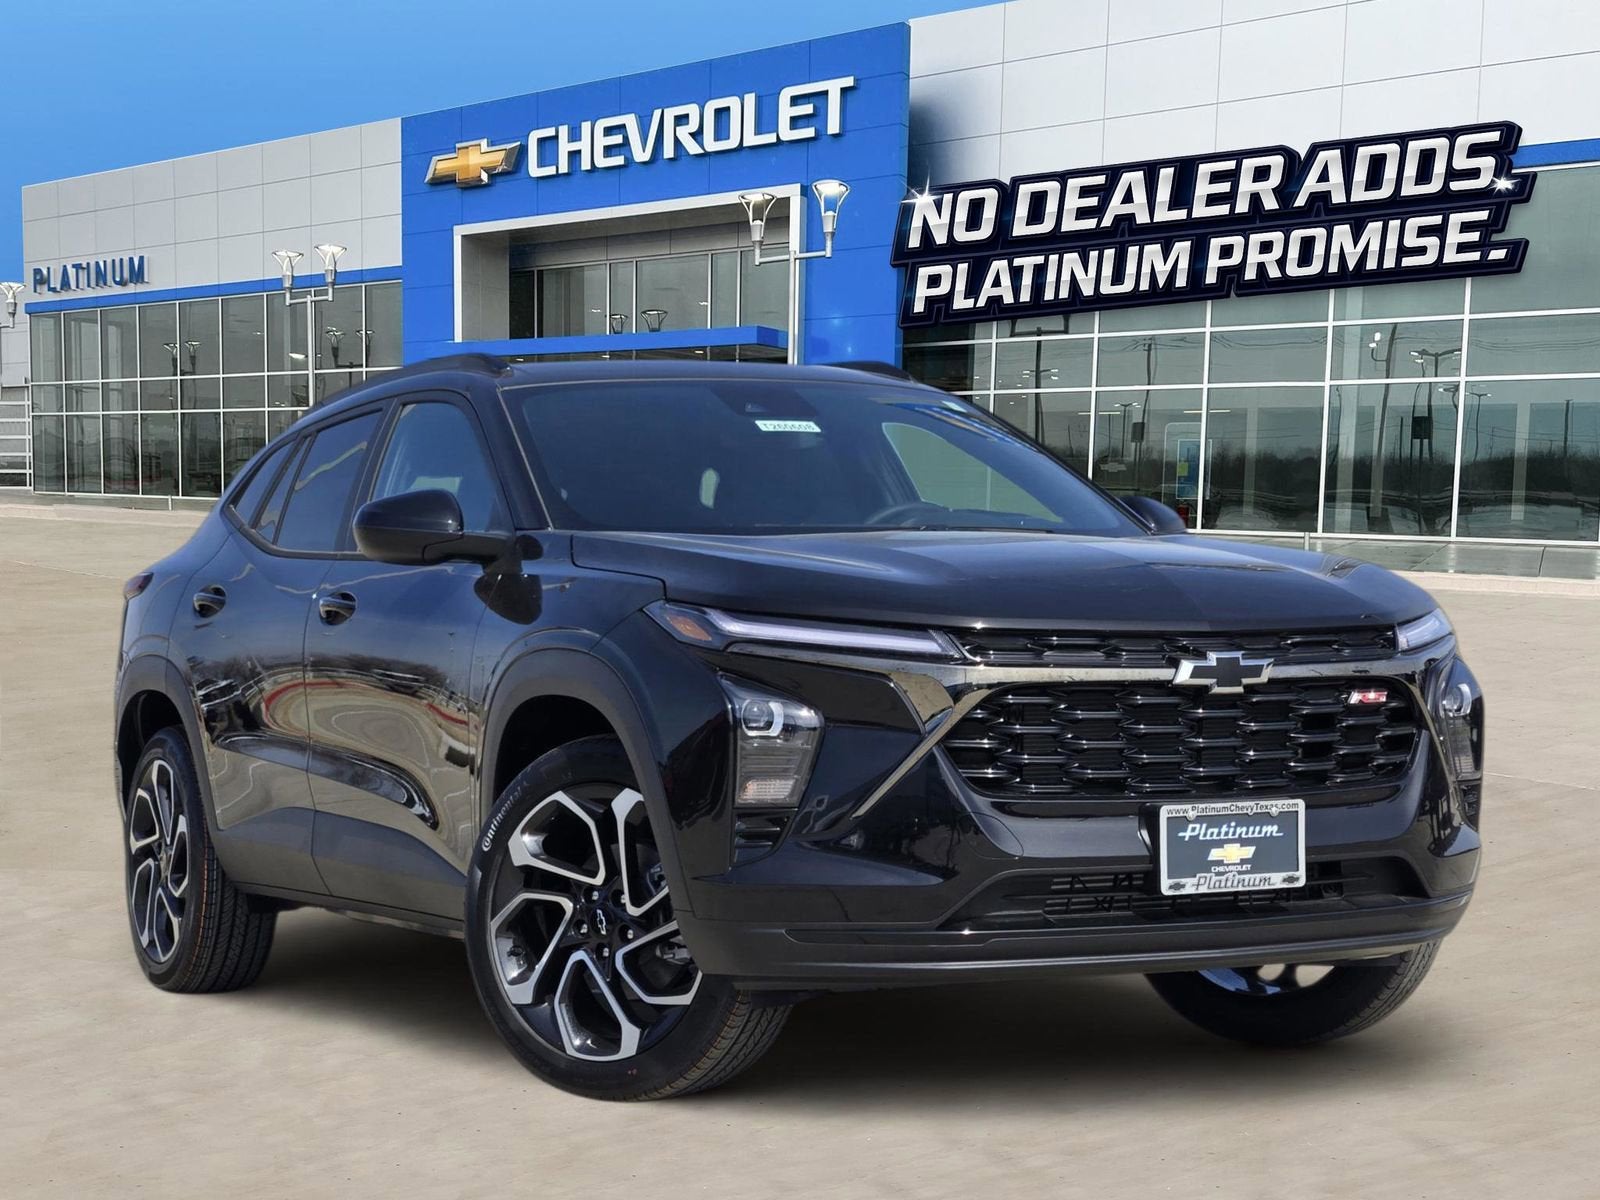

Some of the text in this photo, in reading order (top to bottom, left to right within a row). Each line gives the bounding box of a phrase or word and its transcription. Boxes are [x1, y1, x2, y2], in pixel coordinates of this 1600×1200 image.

[528, 75, 856, 178] CHEVROLET
[33, 255, 146, 294] PLATINUM
[1177, 821, 1284, 842] Platinum
[1211, 864, 1252, 873] CHEVROLET
[1191, 873, 1277, 892] Platinum
